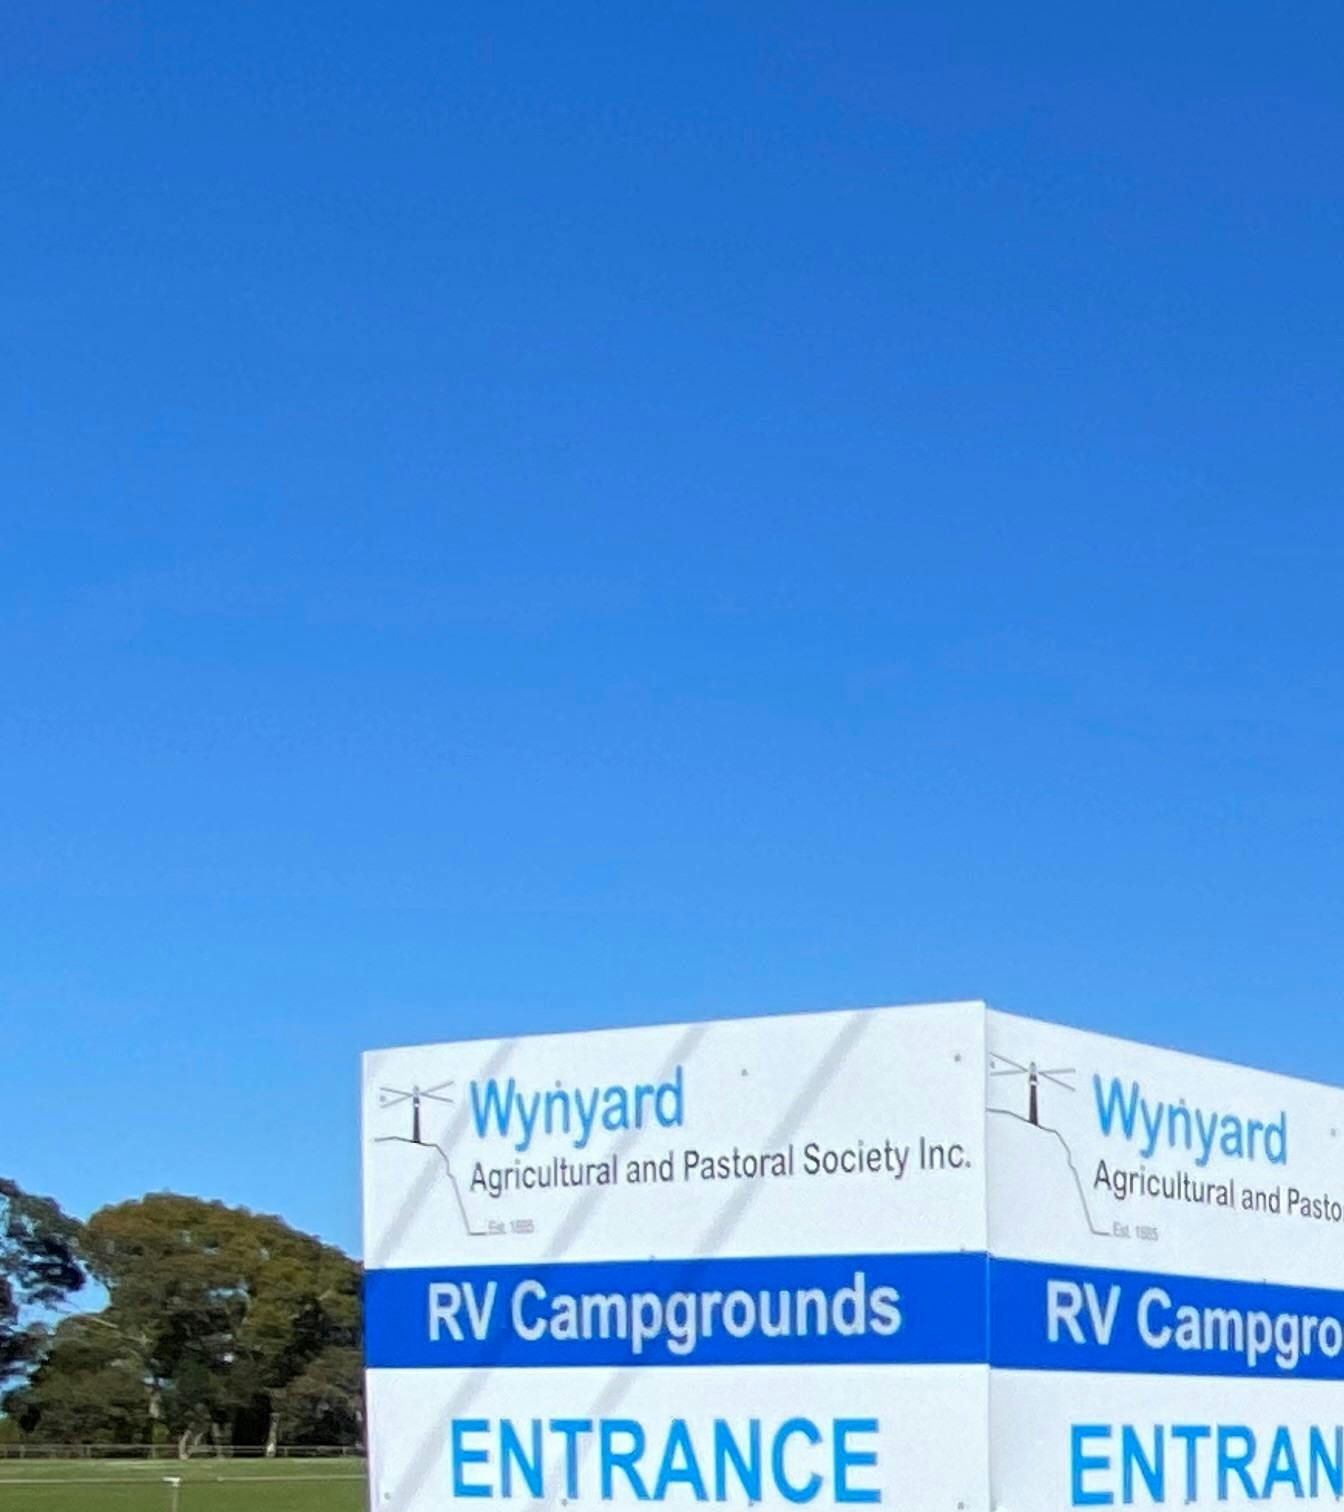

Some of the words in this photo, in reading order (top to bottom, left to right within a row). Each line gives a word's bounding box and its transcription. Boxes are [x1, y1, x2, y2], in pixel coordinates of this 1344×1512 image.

[470, 1066, 684, 1152] Wynyard
[1093, 1073, 1287, 1166] Wynyard
[470, 1153, 618, 1198] Agricultural
[626, 1152, 674, 1184] and
[684, 1145, 794, 1181] Pastoral
[803, 1139, 909, 1180] Society
[920, 1138, 972, 1170] Inc.
[1094, 1160, 1234, 1206] Agricultural
[1241, 1188, 1281, 1214] and
[429, 1281, 496, 1341] RV
[511, 1272, 901, 1355] Campgrounds
[1047, 1280, 1120, 1345] RV
[450, 1416, 882, 1504] ENTRANCE
